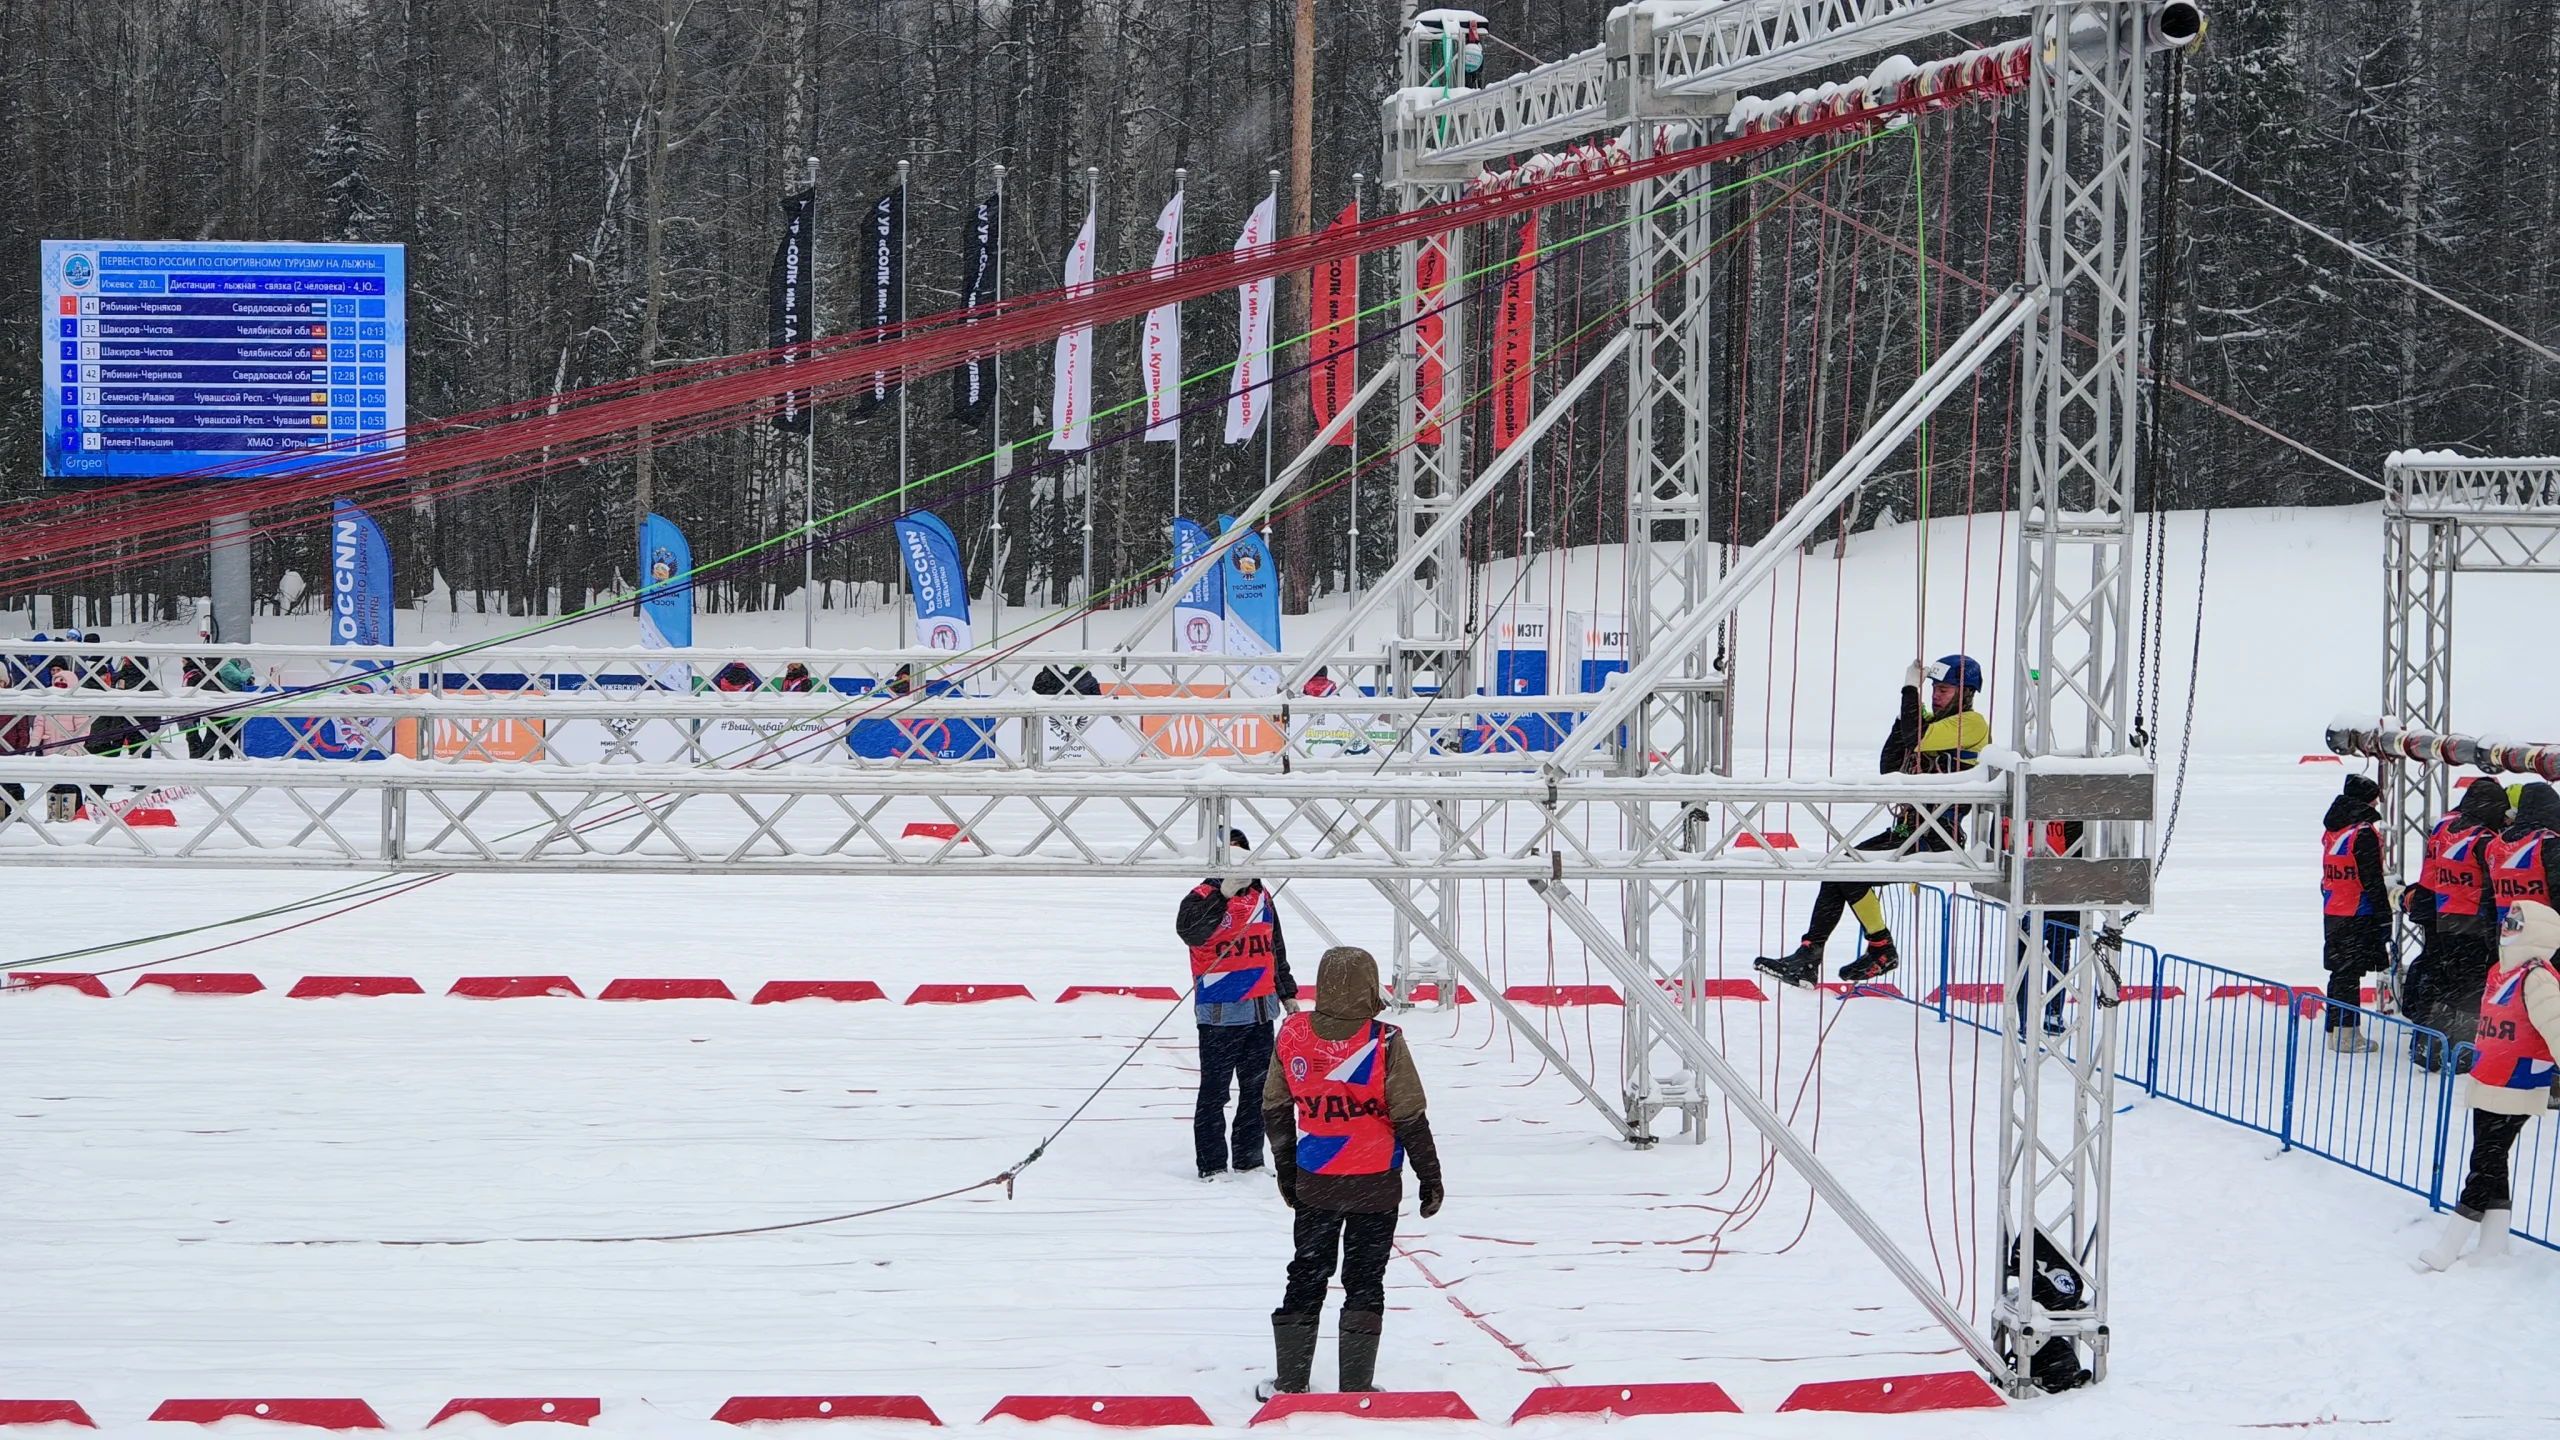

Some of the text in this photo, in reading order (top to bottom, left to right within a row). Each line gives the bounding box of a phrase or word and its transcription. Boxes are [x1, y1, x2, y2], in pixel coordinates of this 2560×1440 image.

[878, 217, 890, 235] УР
[977, 225, 988, 244] УР
[101, 256, 157, 266] ПЕРВЕНСТВО
[159, 257, 196, 267] РОССИИ
[199, 258, 213, 267] ПО
[215, 258, 281, 269] СПОРТИВНОМУ
[284, 258, 323, 268] ТУРИЗМУ
[326, 259, 339, 269] НА
[786, 238, 799, 284] «СОЛК
[878, 239, 890, 285] «СОЛК
[101, 280, 134, 289] Ижевск
[1330, 259, 1341, 296] СОЛК
[169, 280, 215, 290] Дистанция
[293, 281, 302, 292] (2
[304, 282, 346, 292] человека)
[785, 287, 796, 312] им.
[878, 289, 888, 312] им.
[66, 302, 355, 314] 1 41 Рябинин-Черняков Свердловской обл 12:12
[1248, 298, 1258, 321] им.
[1329, 299, 1339, 323] им.
[1507, 302, 1517, 324] им.
[785, 314, 797, 324] Г.
[66, 324, 384, 336] 2 32 Шакиров-Чистов Челябинской обл 12:25 +0:13
[1150, 322, 1160, 331] Г.
[785, 327, 797, 343] А.
[1150, 335, 1161, 350] А.
[1507, 341, 1517, 355] А.
[66, 347, 384, 358] 2 31 Шакиров-Чистов Челябинской обл 12:25 +0:13
[66, 369, 384, 381] 4 42 Рябинин-Черняков Свердловской обл 12:28 +0:16
[67, 392, 73, 401] 5
[86, 392, 96, 401] 21
[101, 393, 175, 402] Семенов-Иванов
[194, 393, 241, 404] Чувашской
[243, 394, 265, 404] Респ.
[273, 394, 310, 404] Чувашия
[333, 394, 355, 403] 13:02
[361, 394, 385, 404] +0:50
[1324, 358, 1338, 424] Кулаково
[67, 415, 73, 424] 6
[86, 415, 97, 424] 22
[101, 415, 175, 424] Семенов-Иванов
[194, 415, 241, 427] Чувашской
[243, 416, 265, 426] Респ.
[273, 416, 310, 427] Чувашия
[333, 416, 355, 426] 13:05
[361, 417, 384, 426] +0:53
[67, 437, 73, 446] 7
[86, 437, 97, 446] 51
[102, 437, 174, 447] Телеев-Паньшин
[247, 438, 274, 447] ХМАО
[282, 438, 307, 449] Югры
[1517, 624, 1544, 637] ИЗТТ
[1215, 934, 1271, 958] СУДЬ
